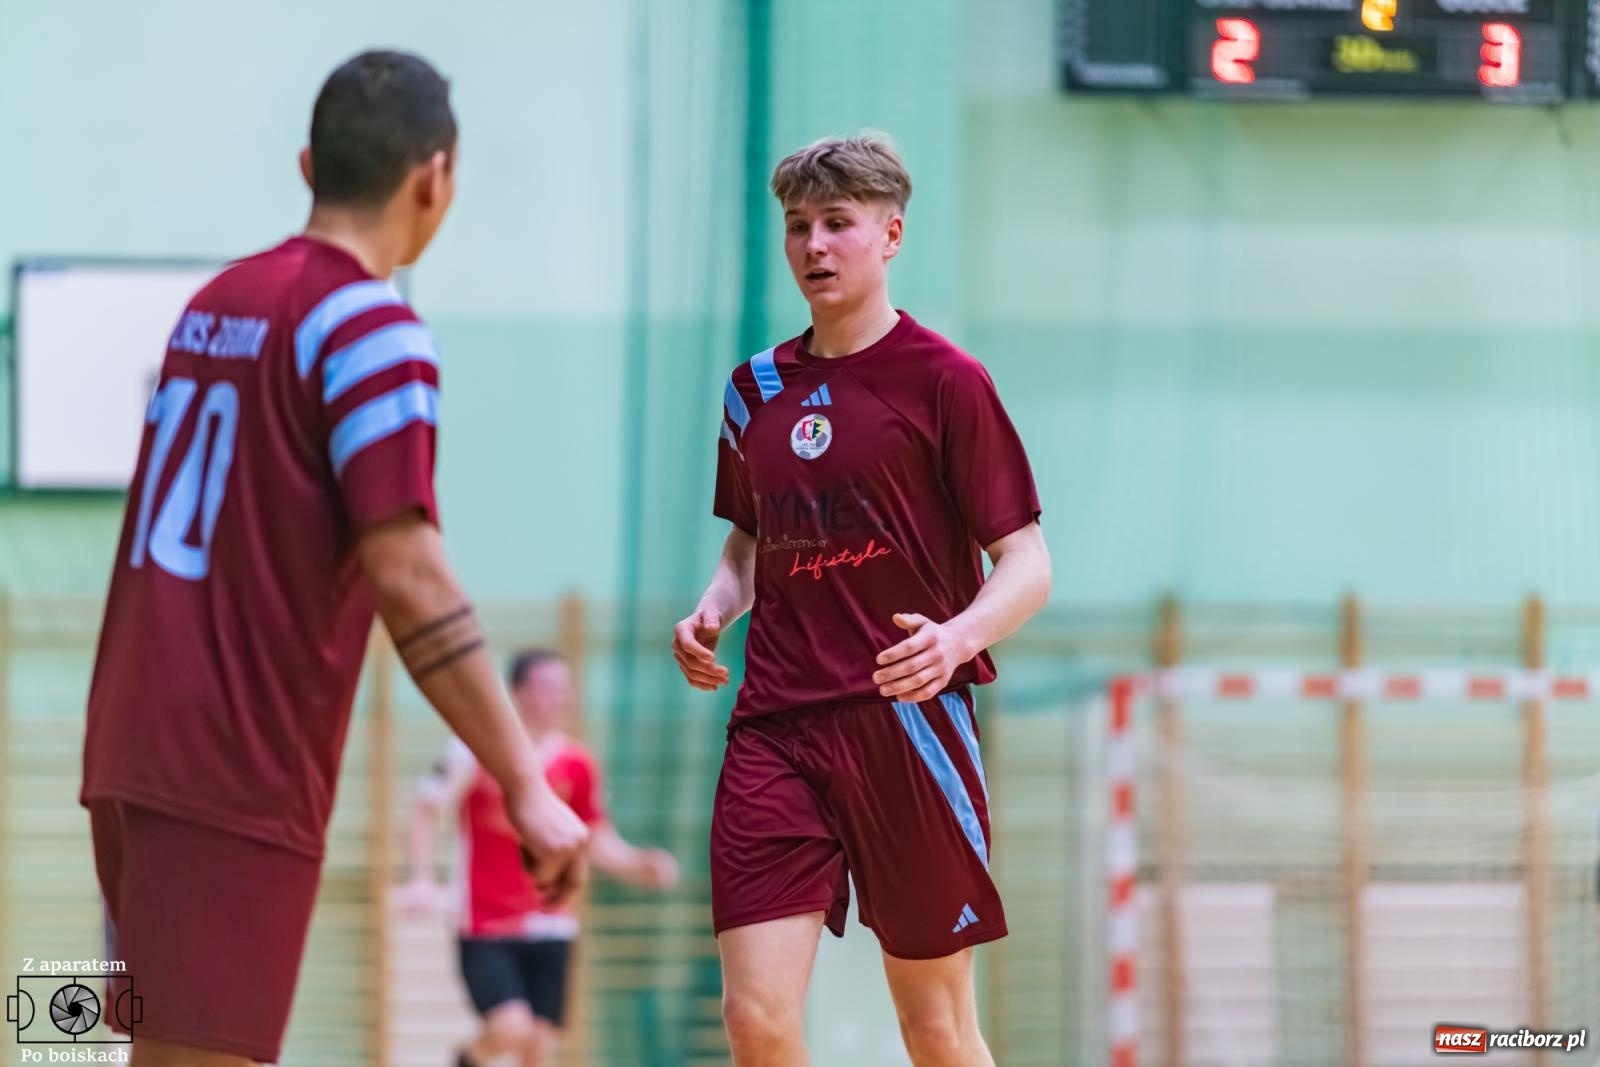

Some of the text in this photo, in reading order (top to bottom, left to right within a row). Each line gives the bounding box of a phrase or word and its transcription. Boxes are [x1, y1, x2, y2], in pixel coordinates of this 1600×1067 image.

[1210, 17, 1260, 83] 2
[1478, 22, 1521, 87] 3
[130, 377, 239, 581] 10
